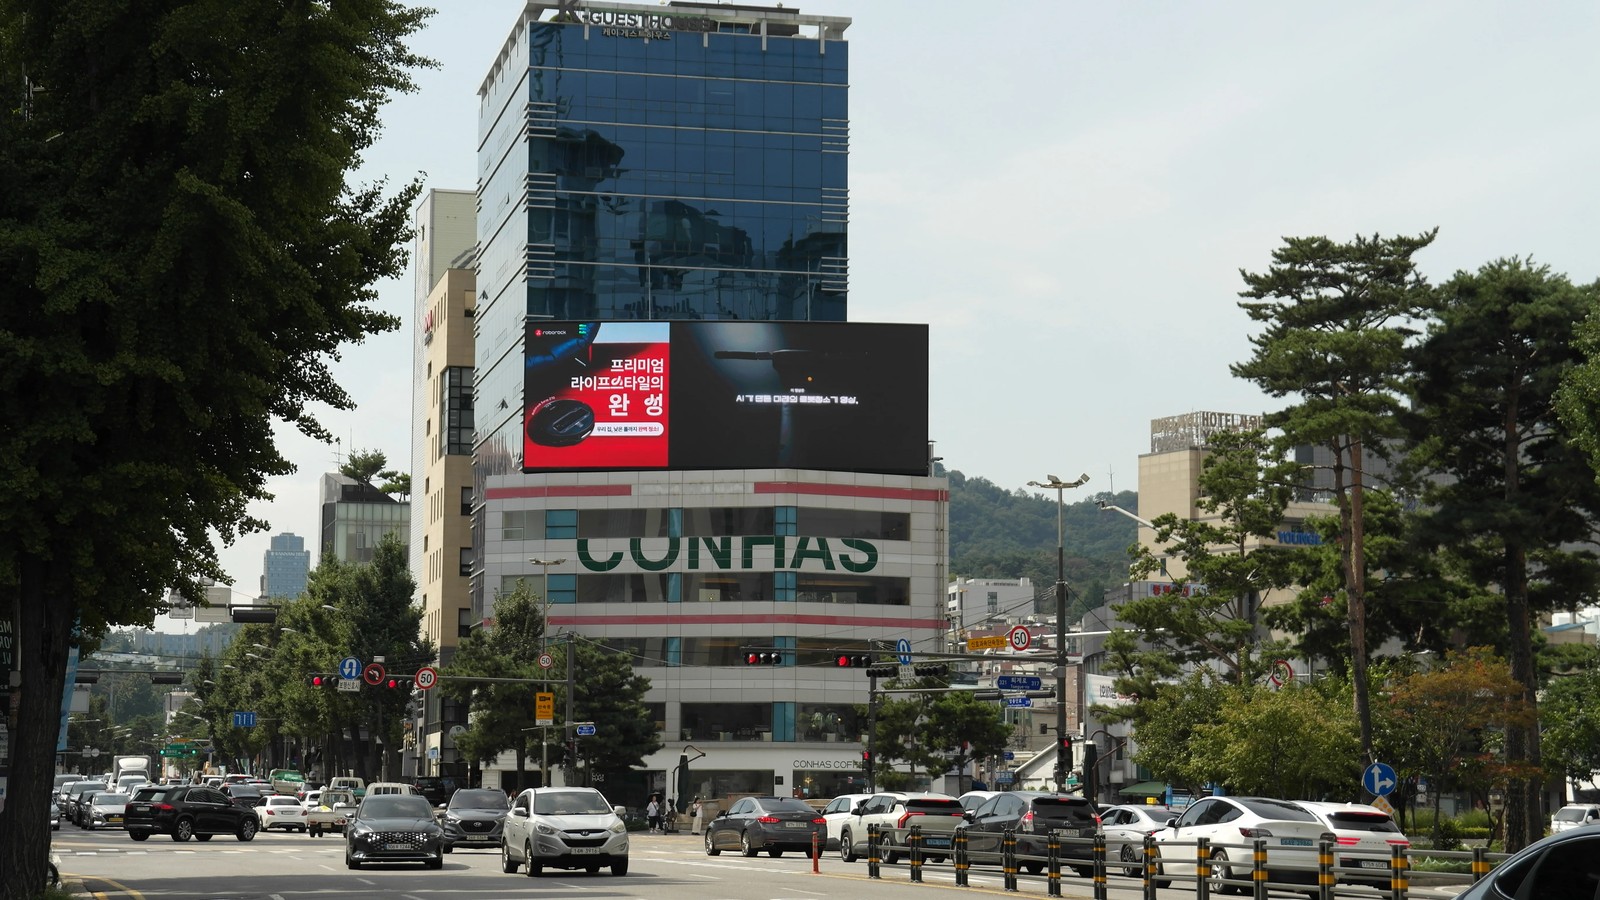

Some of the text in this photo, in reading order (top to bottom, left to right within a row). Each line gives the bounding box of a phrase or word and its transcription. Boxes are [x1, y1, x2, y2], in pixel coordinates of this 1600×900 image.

[610, 358, 664, 374] 프리미엄
[570, 376, 664, 391] 라이프스타일의
[1014, 631, 1026, 645] 50
[420, 674, 432, 683] 50
[793, 760, 832, 769] CONHAS
